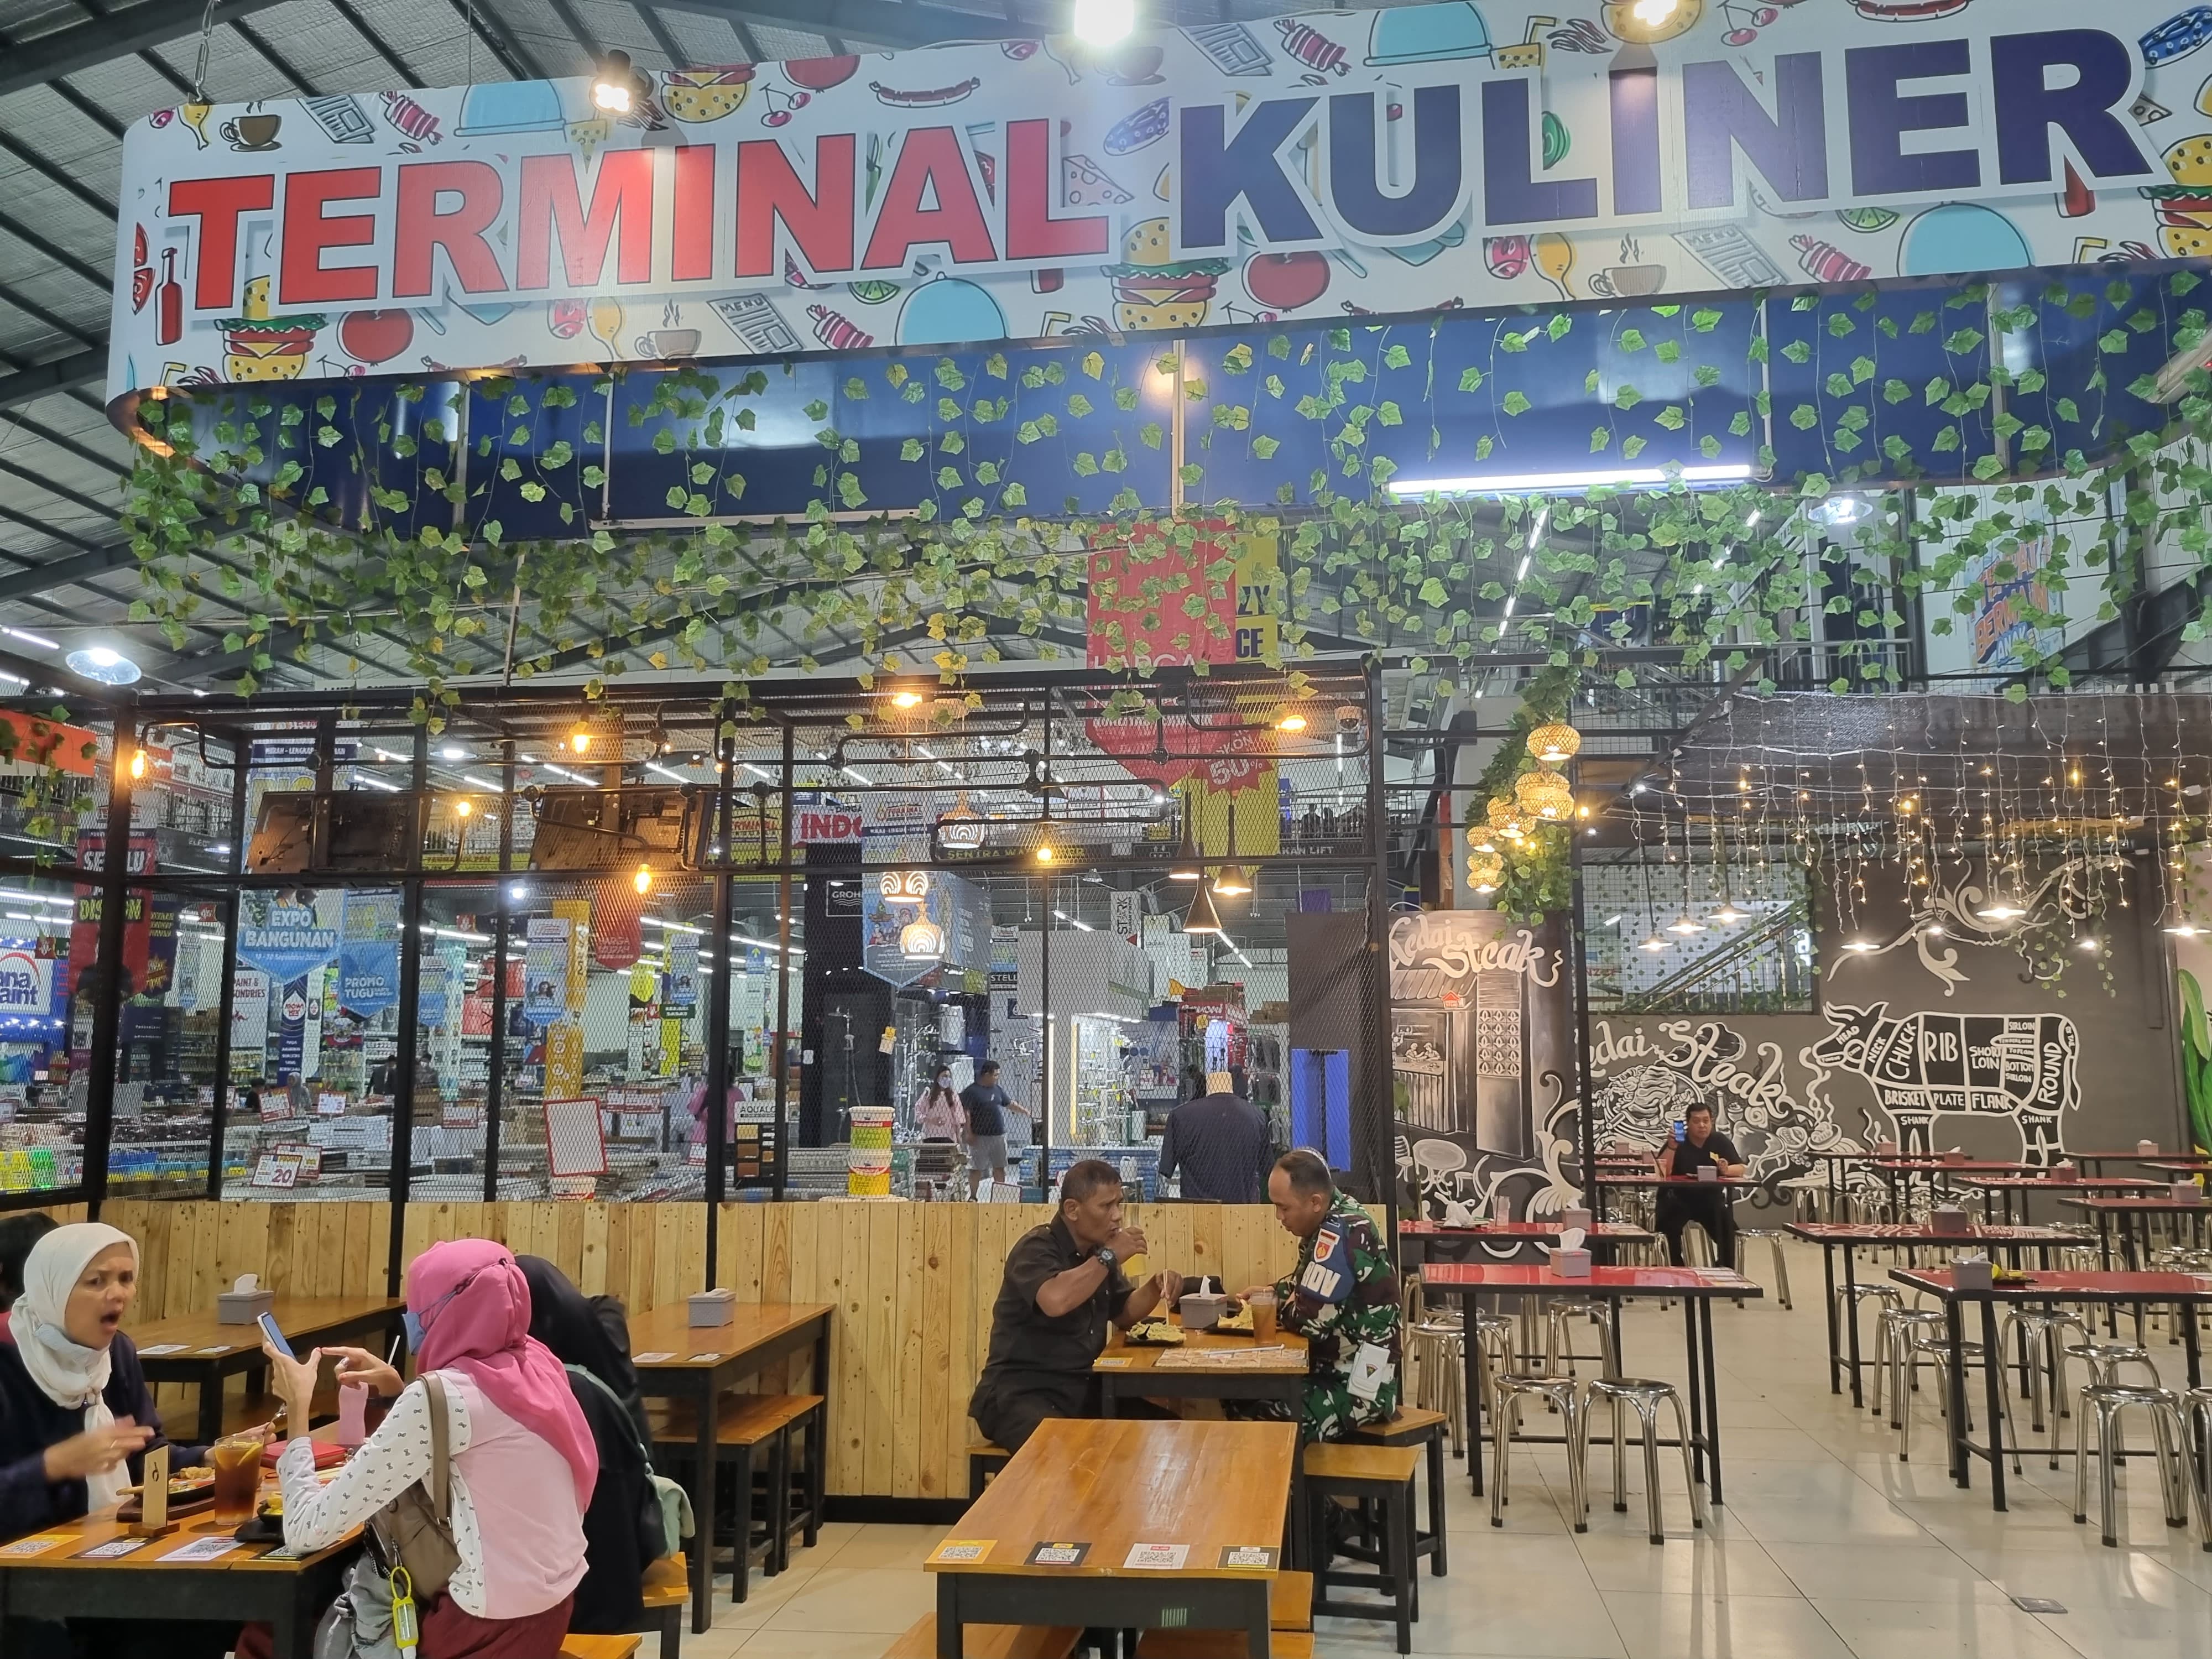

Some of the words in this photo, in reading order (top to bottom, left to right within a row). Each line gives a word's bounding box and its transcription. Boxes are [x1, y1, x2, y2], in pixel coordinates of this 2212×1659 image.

[168, 118, 1108, 310] TERMINAL
[1179, 28, 2153, 250] KULINER
[1687, 227, 1736, 246] MENU
[719, 298, 764, 312] MENU
[1310, 845, 1334, 855] LIFT
[83, 851, 145, 872] SELU
[272, 911, 311, 927] EXPO
[245, 931, 334, 947] BANGUNAN
[1389, 914, 1452, 968] Kedai
[1422, 929, 1564, 988] Steak
[234, 978, 252, 987] AINT
[345, 977, 384, 988] PROMO
[345, 988, 374, 998] TUGU
[2008, 1021, 2035, 1031] SIRLOIN
[1835, 1025, 1860, 1045] HEAD
[1867, 1036, 1887, 1063] NECK
[1885, 1022, 1917, 1080] CHUCK
[1924, 1031, 1959, 1062] RIB
[1968, 1046, 2002, 1058] SHORT
[1658, 1020, 1790, 1119] Steak
[1971, 1057, 2001, 1070] LOIN
[2005, 1061, 2034, 1072] BOTTOM
[2037, 1042, 2063, 1105] ROUND
[1884, 1089, 1926, 1107] BRISKET
[1933, 1093, 1965, 1107] PLATE
[1971, 1093, 2013, 1110] FLANK
[1900, 1115, 1929, 1126] SHANK
[2021, 1115, 2053, 1124] SHANK
[272, 1168, 293, 1183] 20
